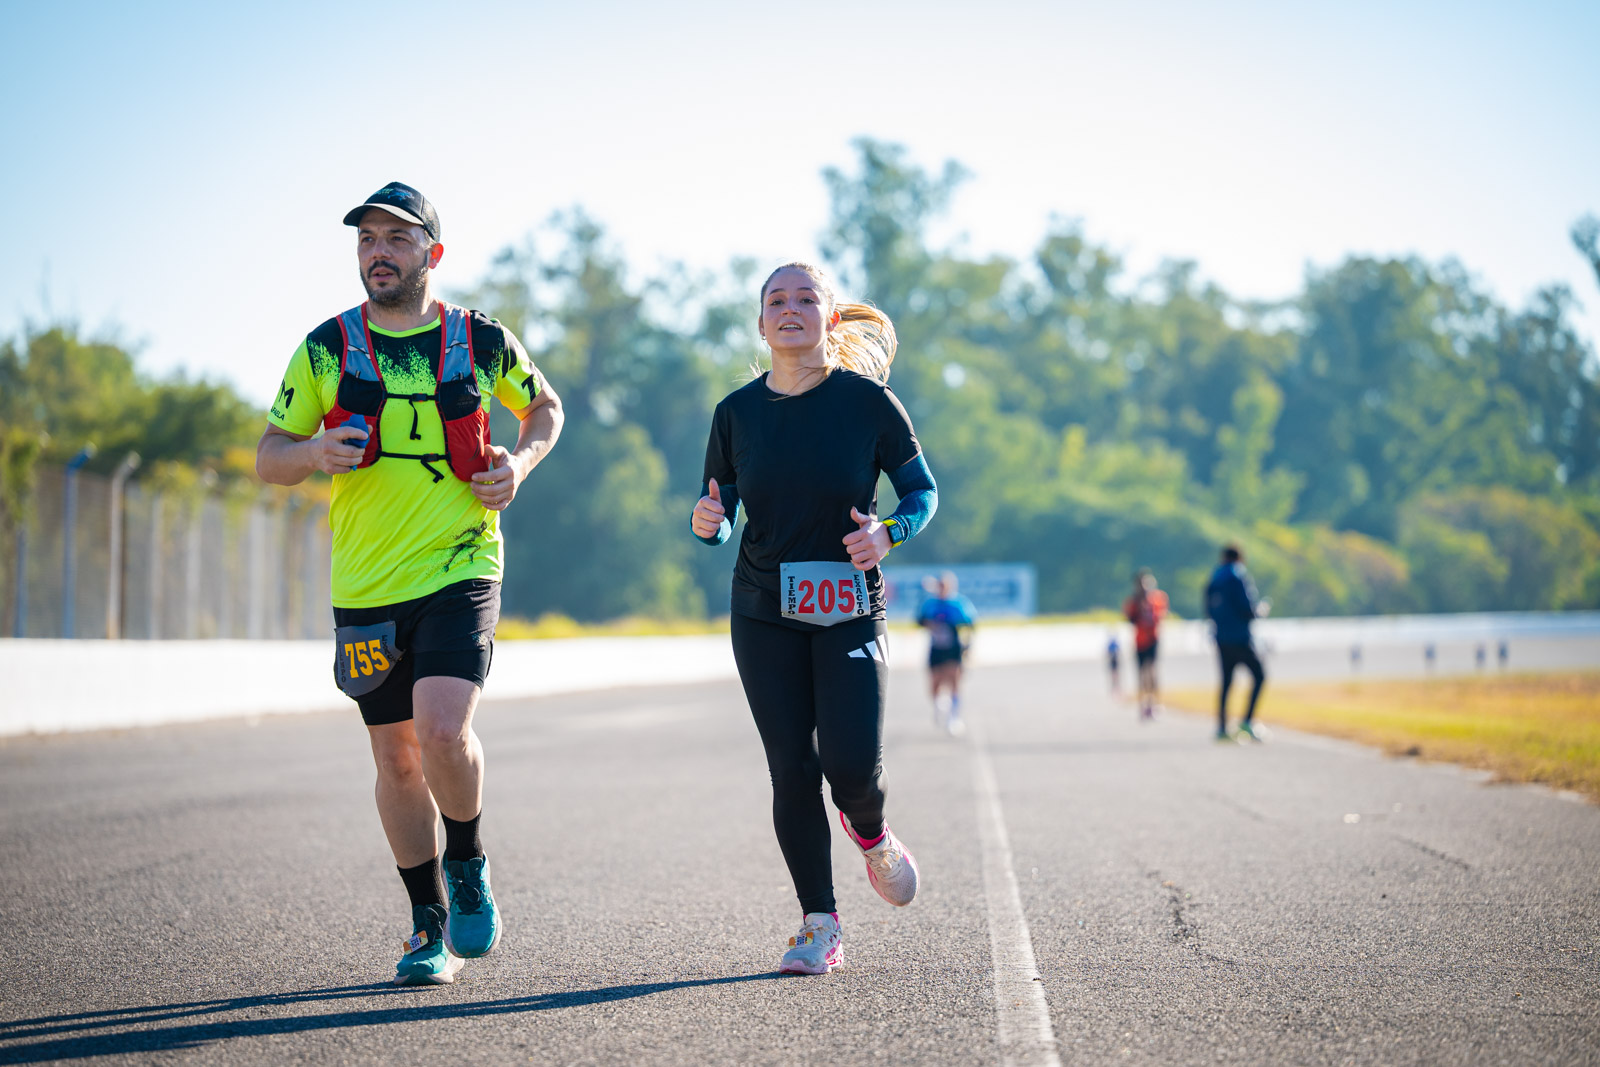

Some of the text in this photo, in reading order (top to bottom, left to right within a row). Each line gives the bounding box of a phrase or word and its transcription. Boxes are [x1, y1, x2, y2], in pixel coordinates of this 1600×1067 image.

[787, 576, 797, 615] TIEMPO
[798, 579, 855, 614] 205
[853, 574, 864, 615] EXACTO
[338, 640, 347, 683] TIEMPO
[344, 639, 390, 678] 755
